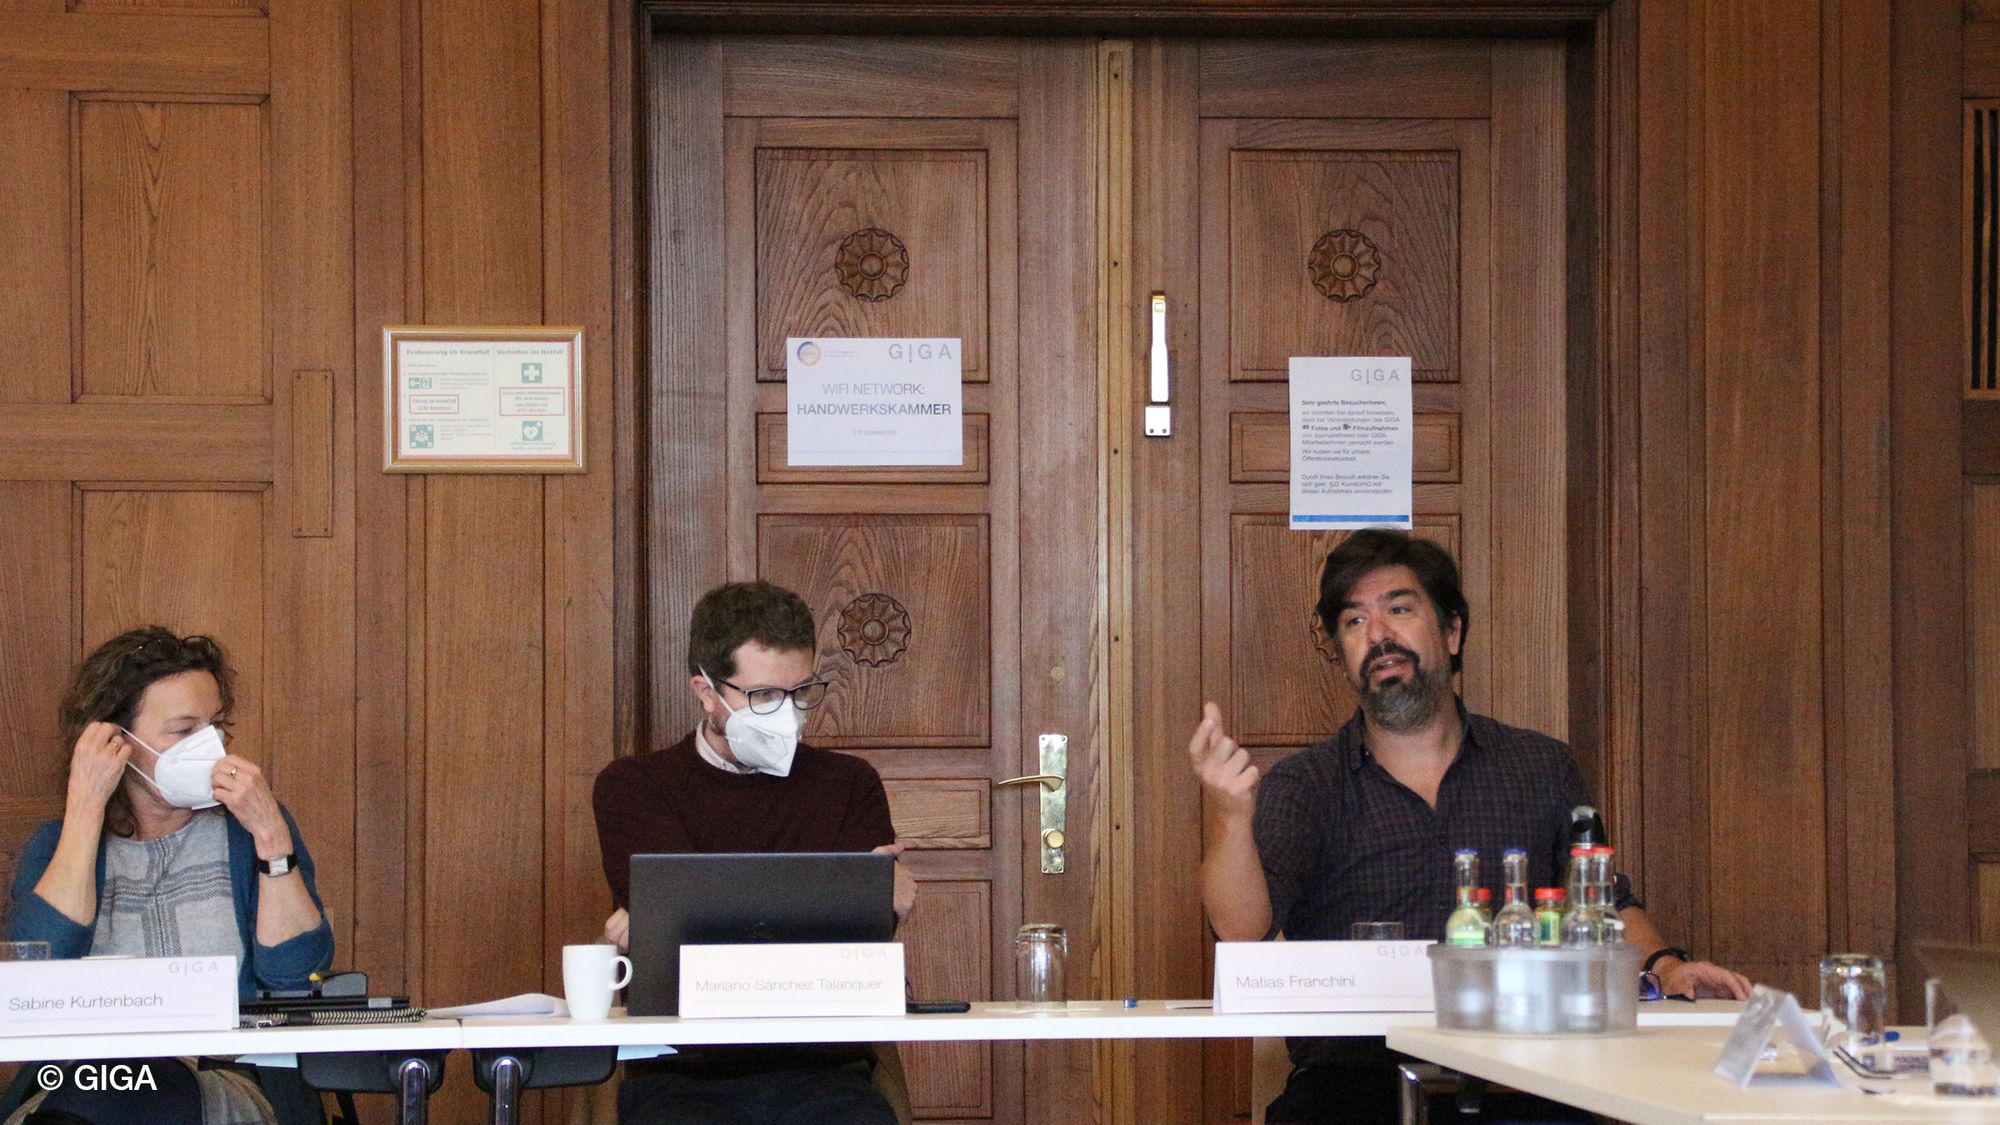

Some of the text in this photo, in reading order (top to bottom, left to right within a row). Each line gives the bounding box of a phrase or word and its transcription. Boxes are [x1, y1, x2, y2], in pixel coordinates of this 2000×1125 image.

[822, 383, 925, 396] WIFI NETWORK:
[797, 404, 952, 416] HANDWERKSKAMMER
[696, 980, 750, 992] Mariano
[816, 978, 882, 992] Talanquer
[1236, 975, 1356, 988] Matias Franchini
[8, 994, 163, 1012] Sabine Kurtenbach
